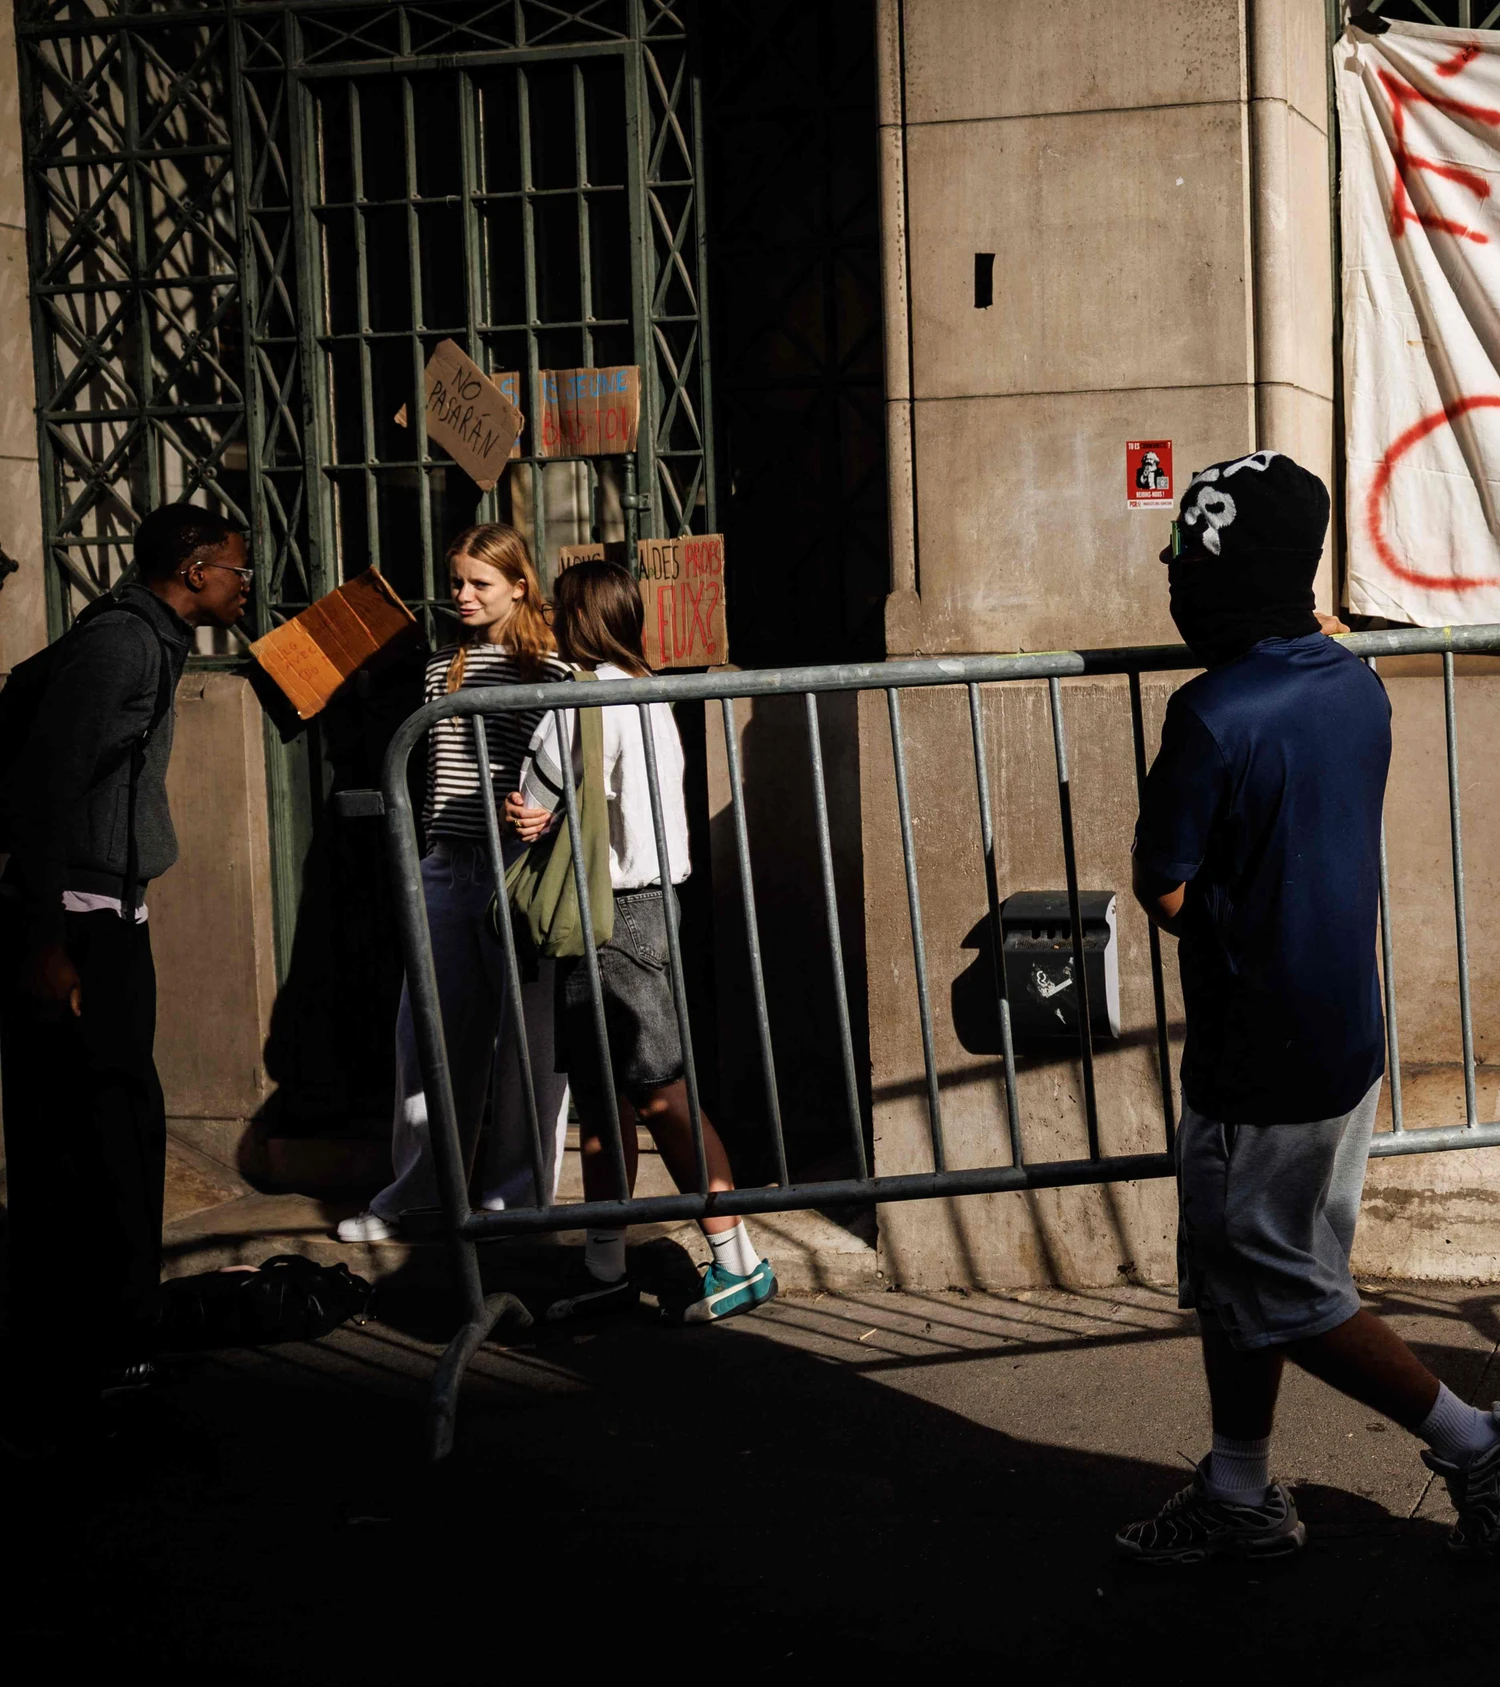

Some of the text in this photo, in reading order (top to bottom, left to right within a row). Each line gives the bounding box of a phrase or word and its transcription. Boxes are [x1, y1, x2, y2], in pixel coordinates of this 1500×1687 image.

[452, 366, 482, 401] NO
[566, 371, 628, 401] JEUNE
[652, 545, 680, 580] DES
[685, 540, 722, 579] PROFS
